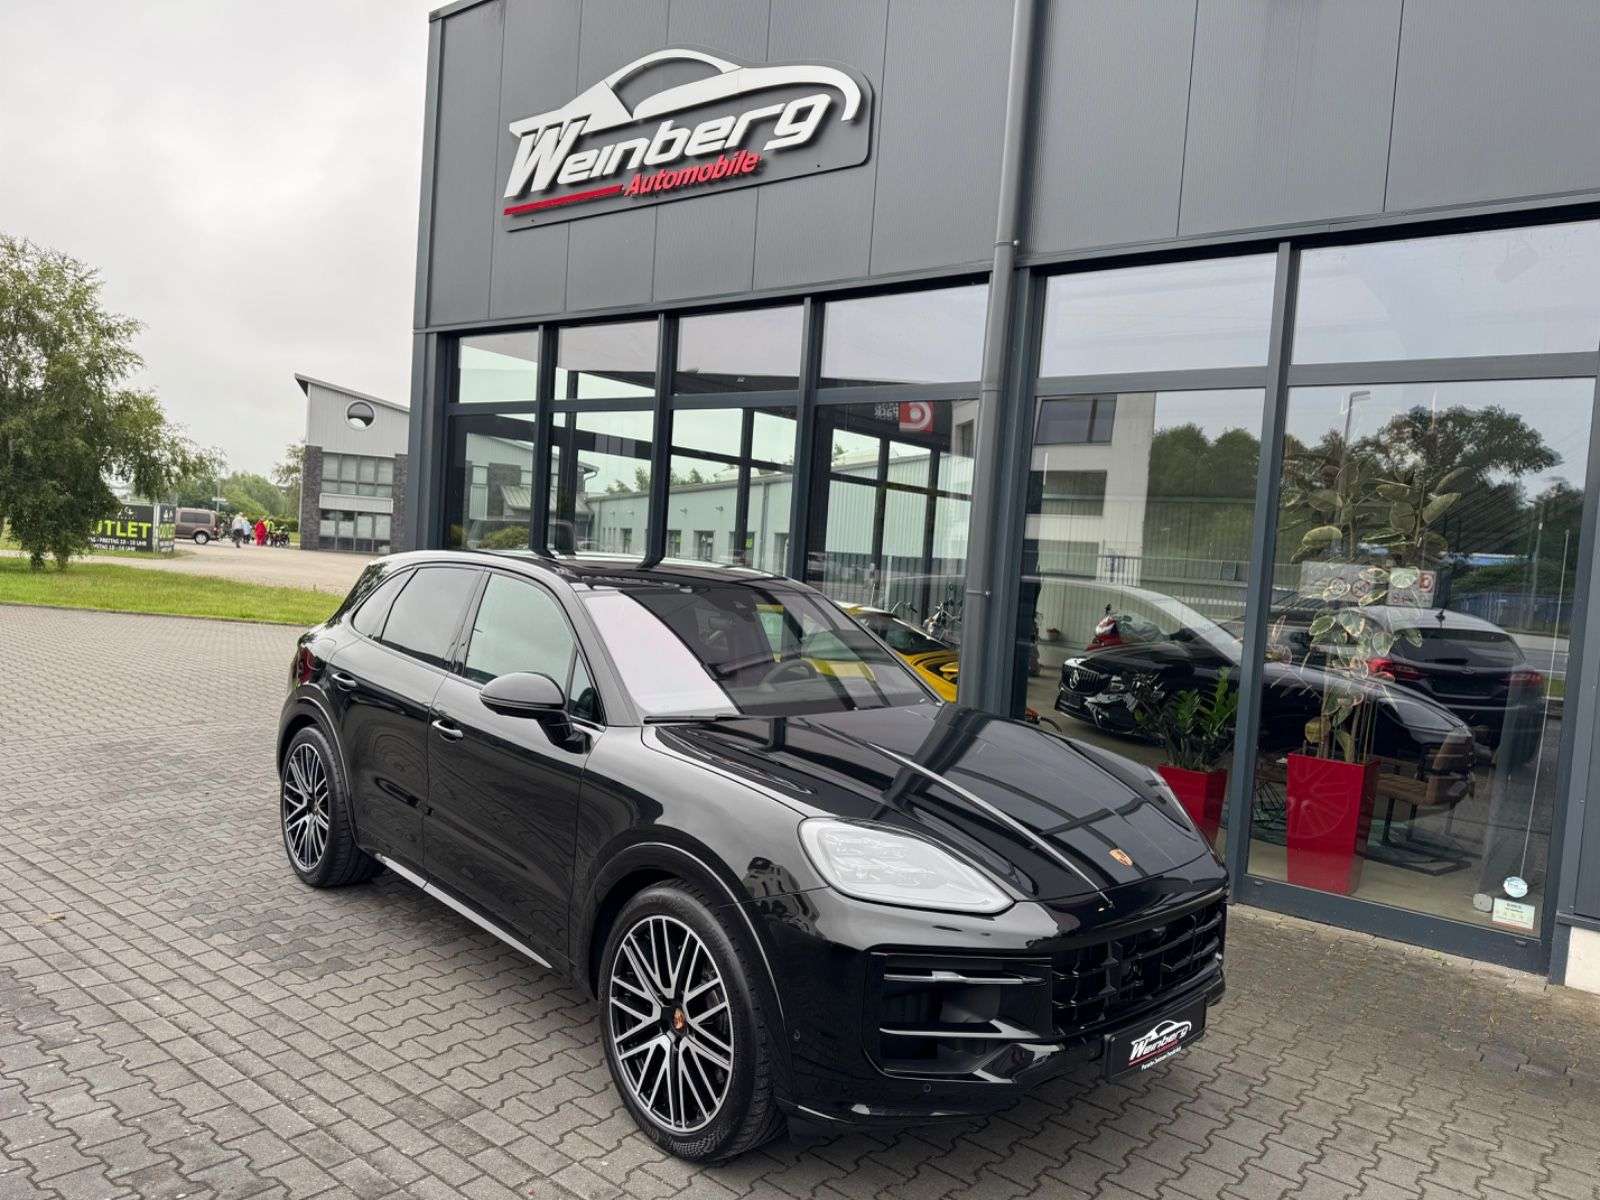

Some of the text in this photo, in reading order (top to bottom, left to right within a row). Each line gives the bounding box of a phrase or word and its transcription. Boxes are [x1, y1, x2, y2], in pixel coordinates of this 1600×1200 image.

[503, 93, 832, 198] Weinberg
[624, 149, 762, 197] Automobile
[1129, 1025, 1189, 1061] Weinberg
